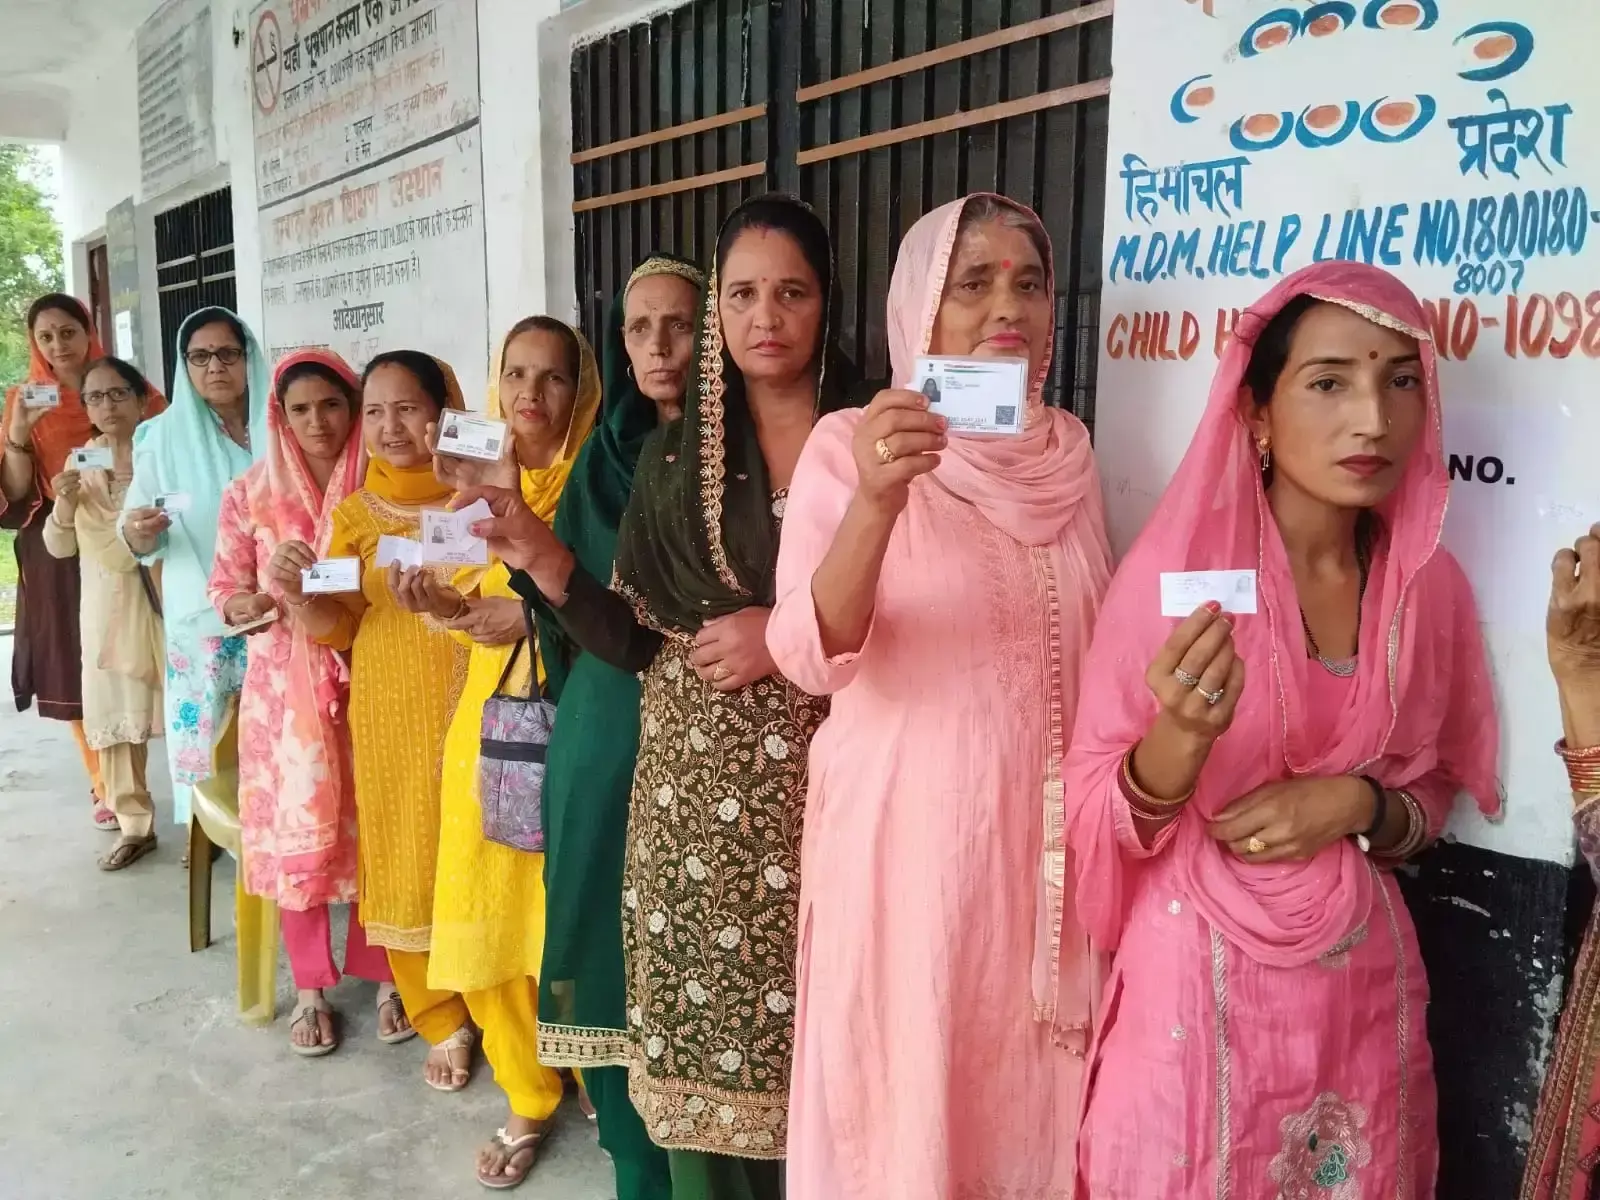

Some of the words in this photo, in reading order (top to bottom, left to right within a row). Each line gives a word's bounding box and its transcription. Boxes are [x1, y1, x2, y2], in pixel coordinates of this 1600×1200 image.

[336, 3, 361, 45] करना
[1447, 88, 1573, 180] प्रदेश
[1119, 153, 1252, 226] हिमाचल
[1312, 203, 1409, 265] LINE
[1453, 260, 1524, 295] 8007
[1106, 311, 1200, 361] CHILD
[1448, 454, 1515, 485] NO.
